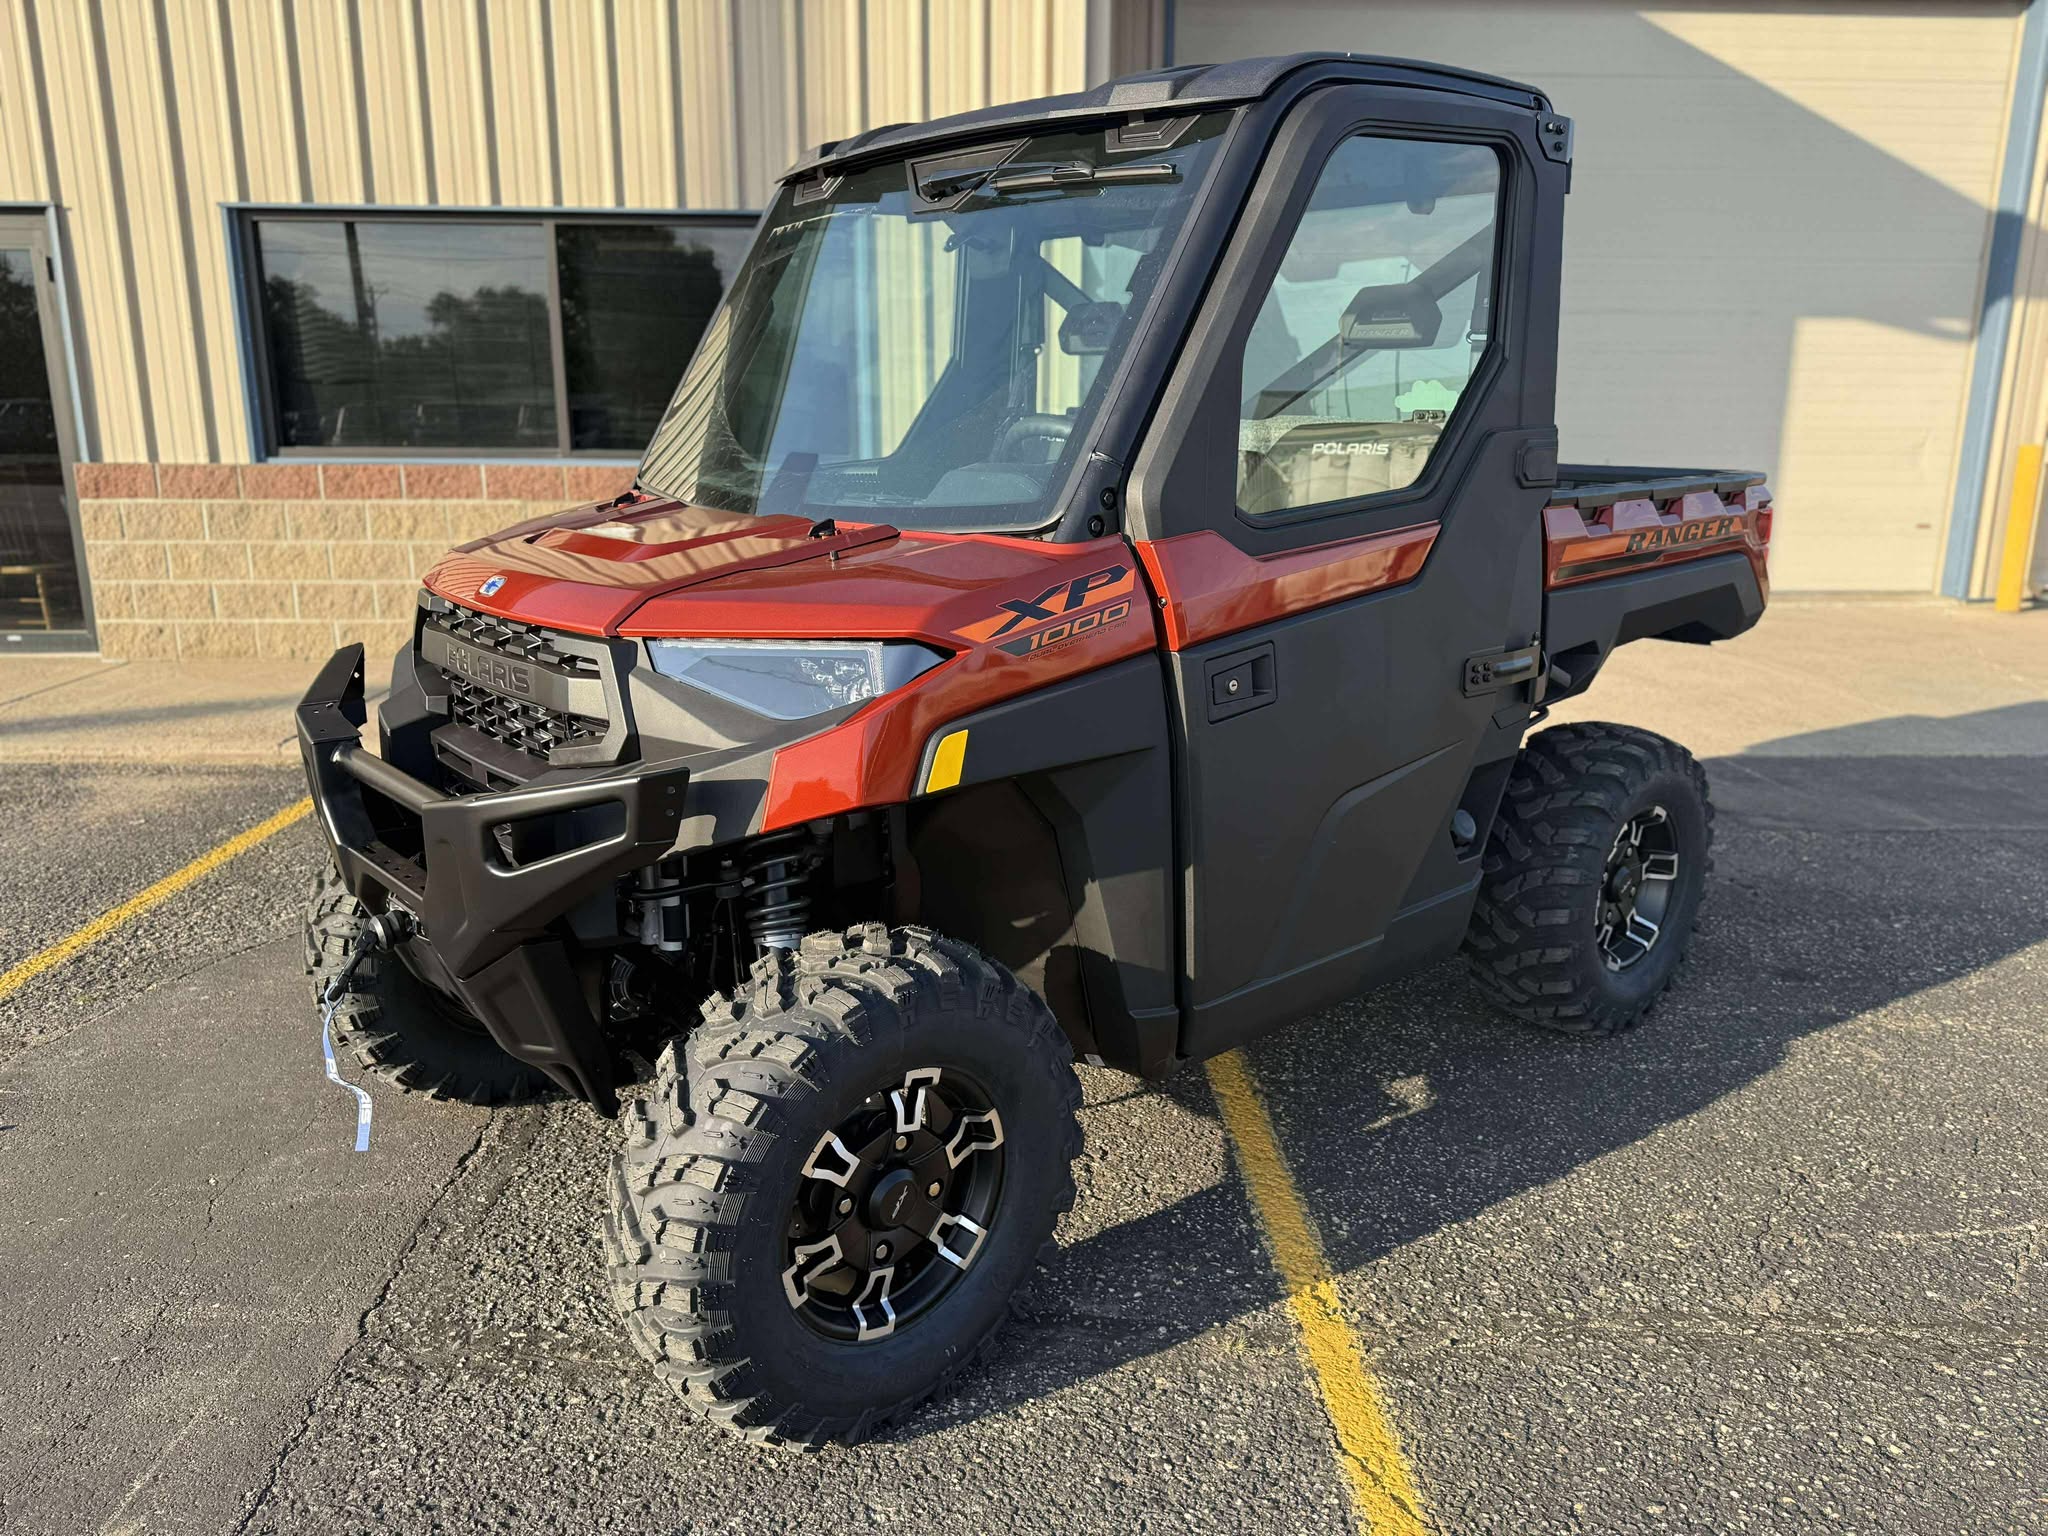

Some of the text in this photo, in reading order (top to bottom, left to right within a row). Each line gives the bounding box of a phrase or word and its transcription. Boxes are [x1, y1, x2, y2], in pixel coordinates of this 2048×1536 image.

[1312, 443, 1389, 455] POLARIS
[1625, 517, 1735, 554] RANGER
[986, 564, 1129, 640] XP
[1029, 600, 1130, 651] 1000
[446, 643, 530, 695] POLARIS
